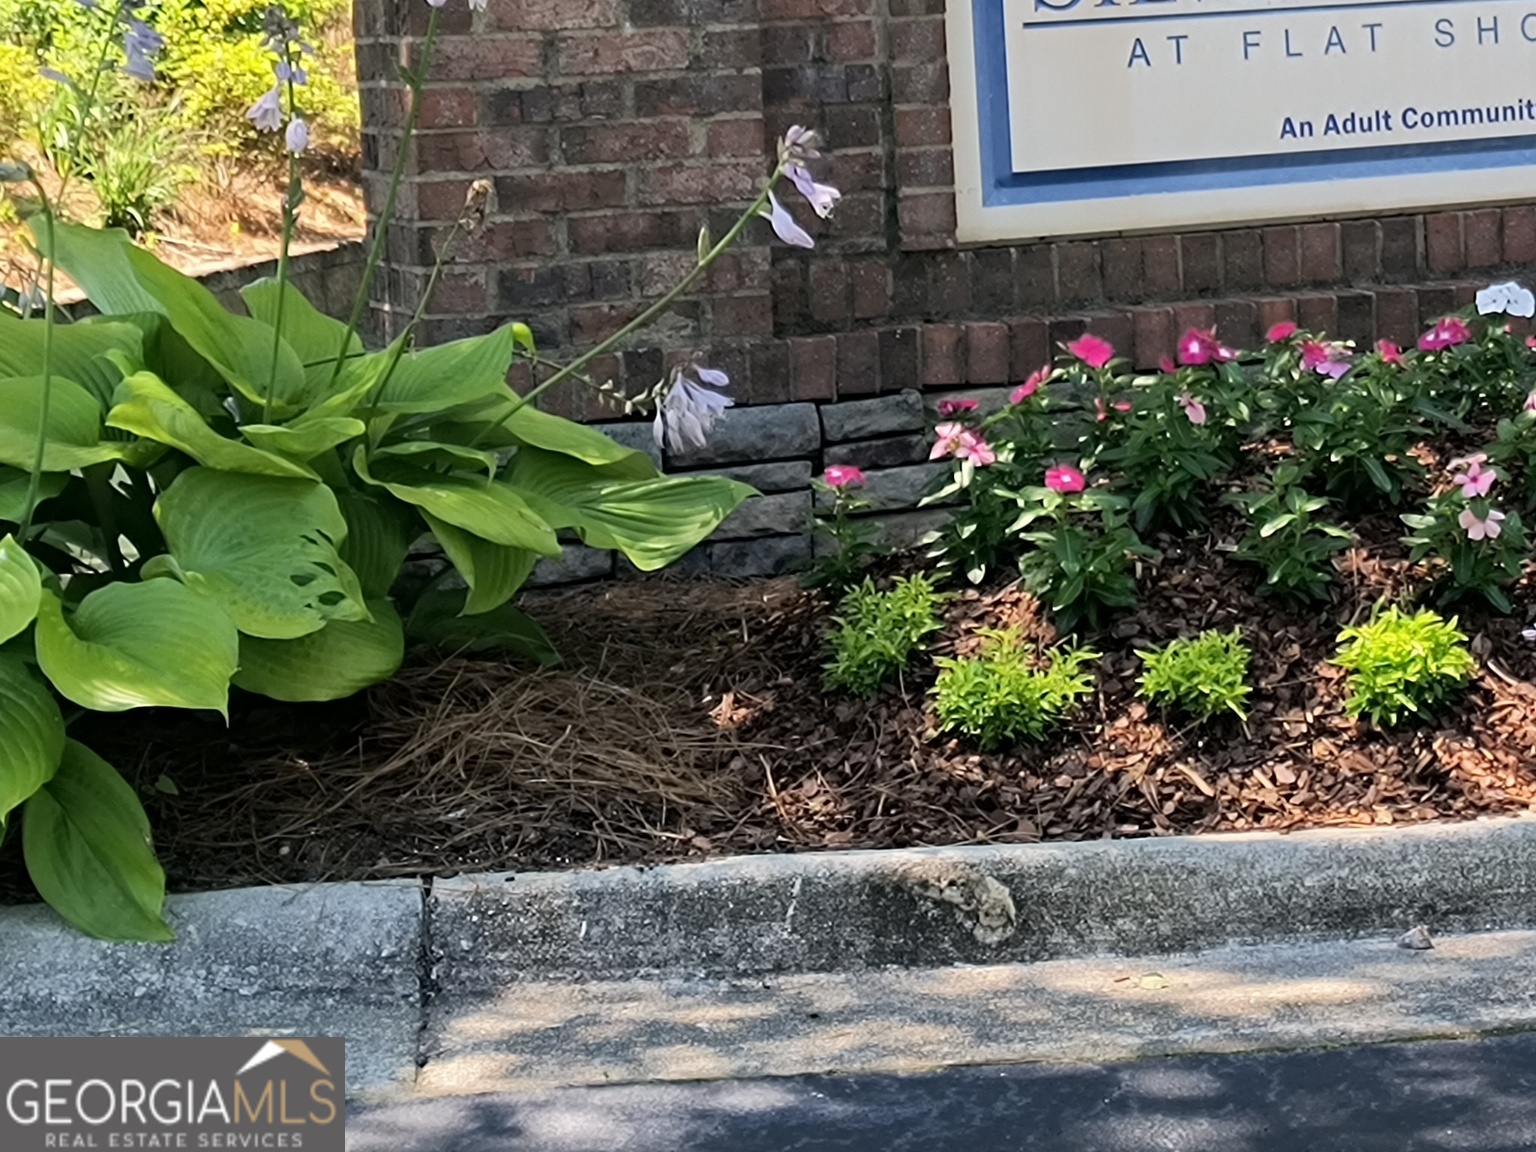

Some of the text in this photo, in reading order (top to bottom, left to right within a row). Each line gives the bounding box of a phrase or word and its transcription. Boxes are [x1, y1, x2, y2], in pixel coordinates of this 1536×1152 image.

[1127, 34, 1189, 68] AT
[1242, 23, 1382, 60] FLAT
[1279, 115, 1314, 139] An
[1323, 110, 1392, 136] Adult
